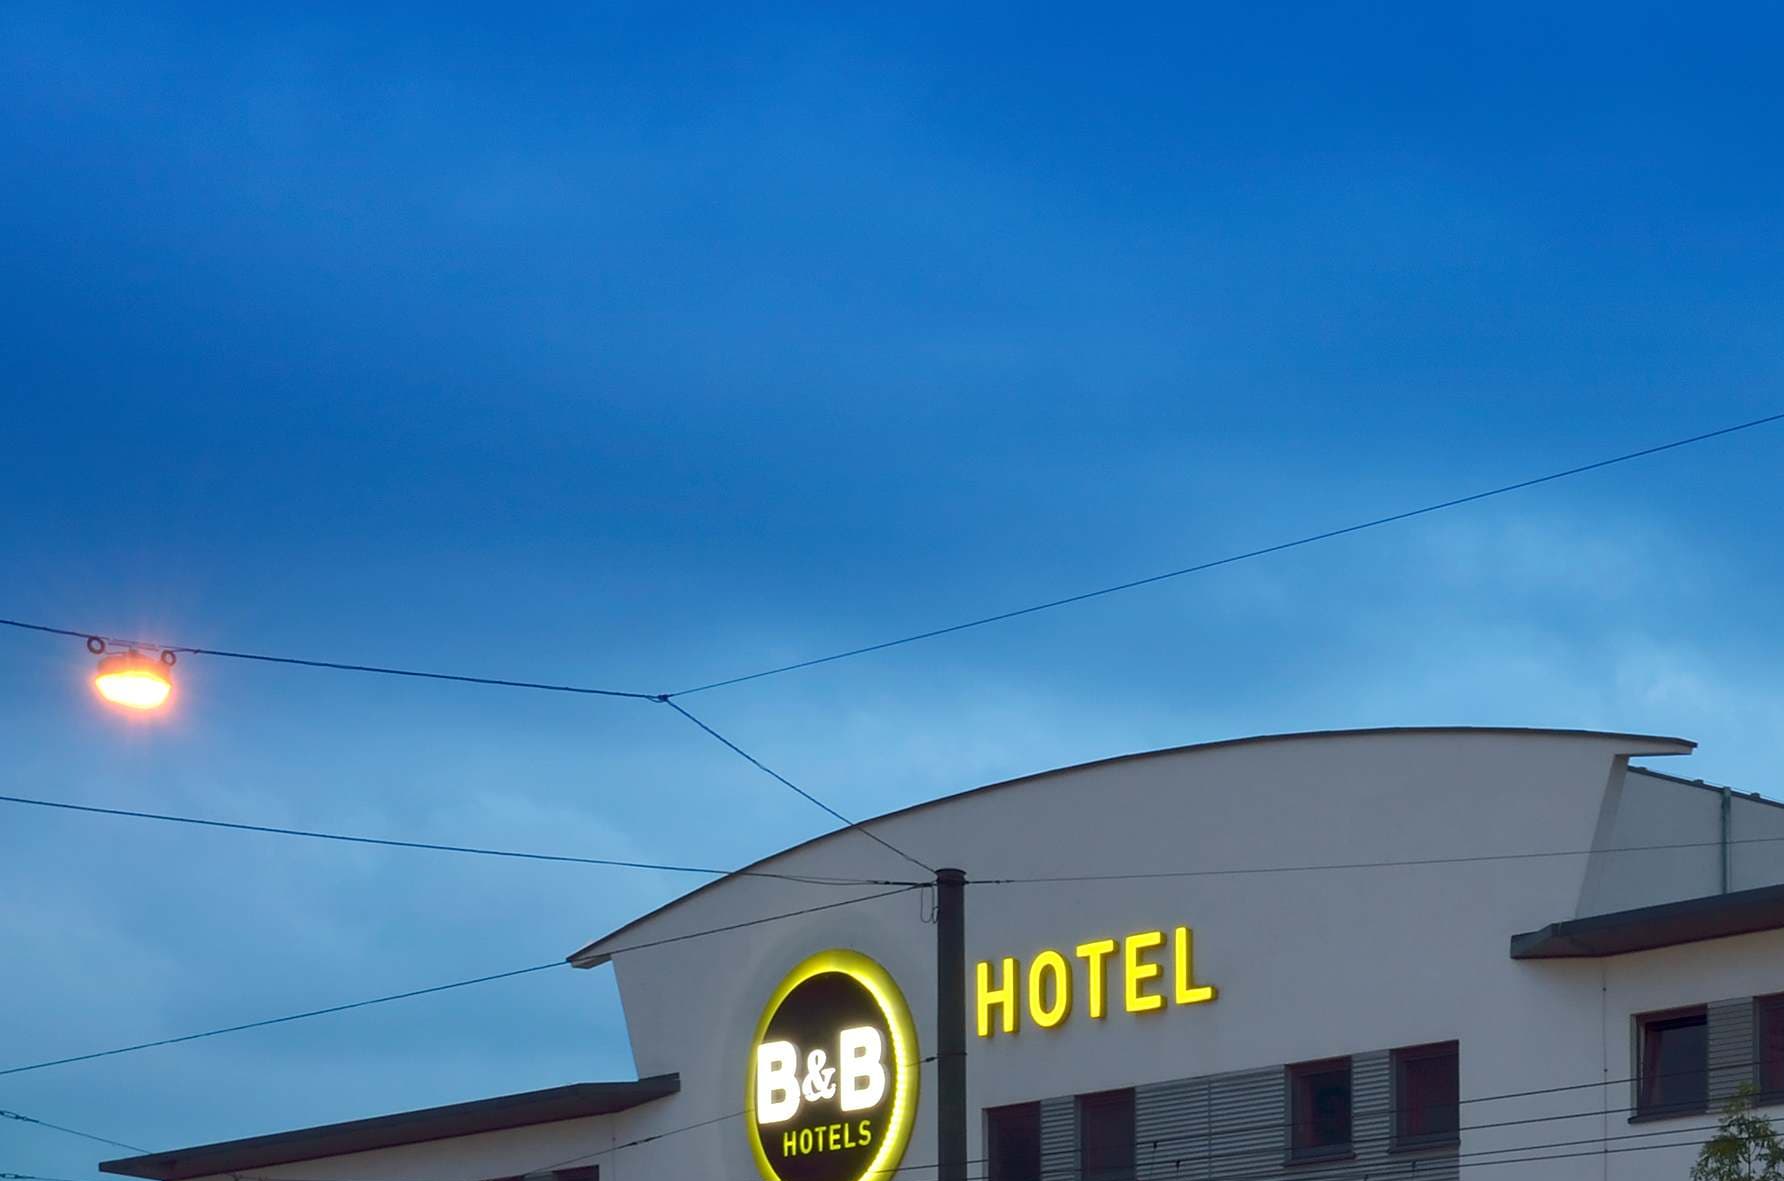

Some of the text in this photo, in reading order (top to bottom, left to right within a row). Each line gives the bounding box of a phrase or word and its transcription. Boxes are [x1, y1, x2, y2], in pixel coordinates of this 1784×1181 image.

[976, 926, 1217, 1037] HOTEL
[757, 1026, 886, 1125] B&B
[783, 1120, 872, 1157] HOTELS
